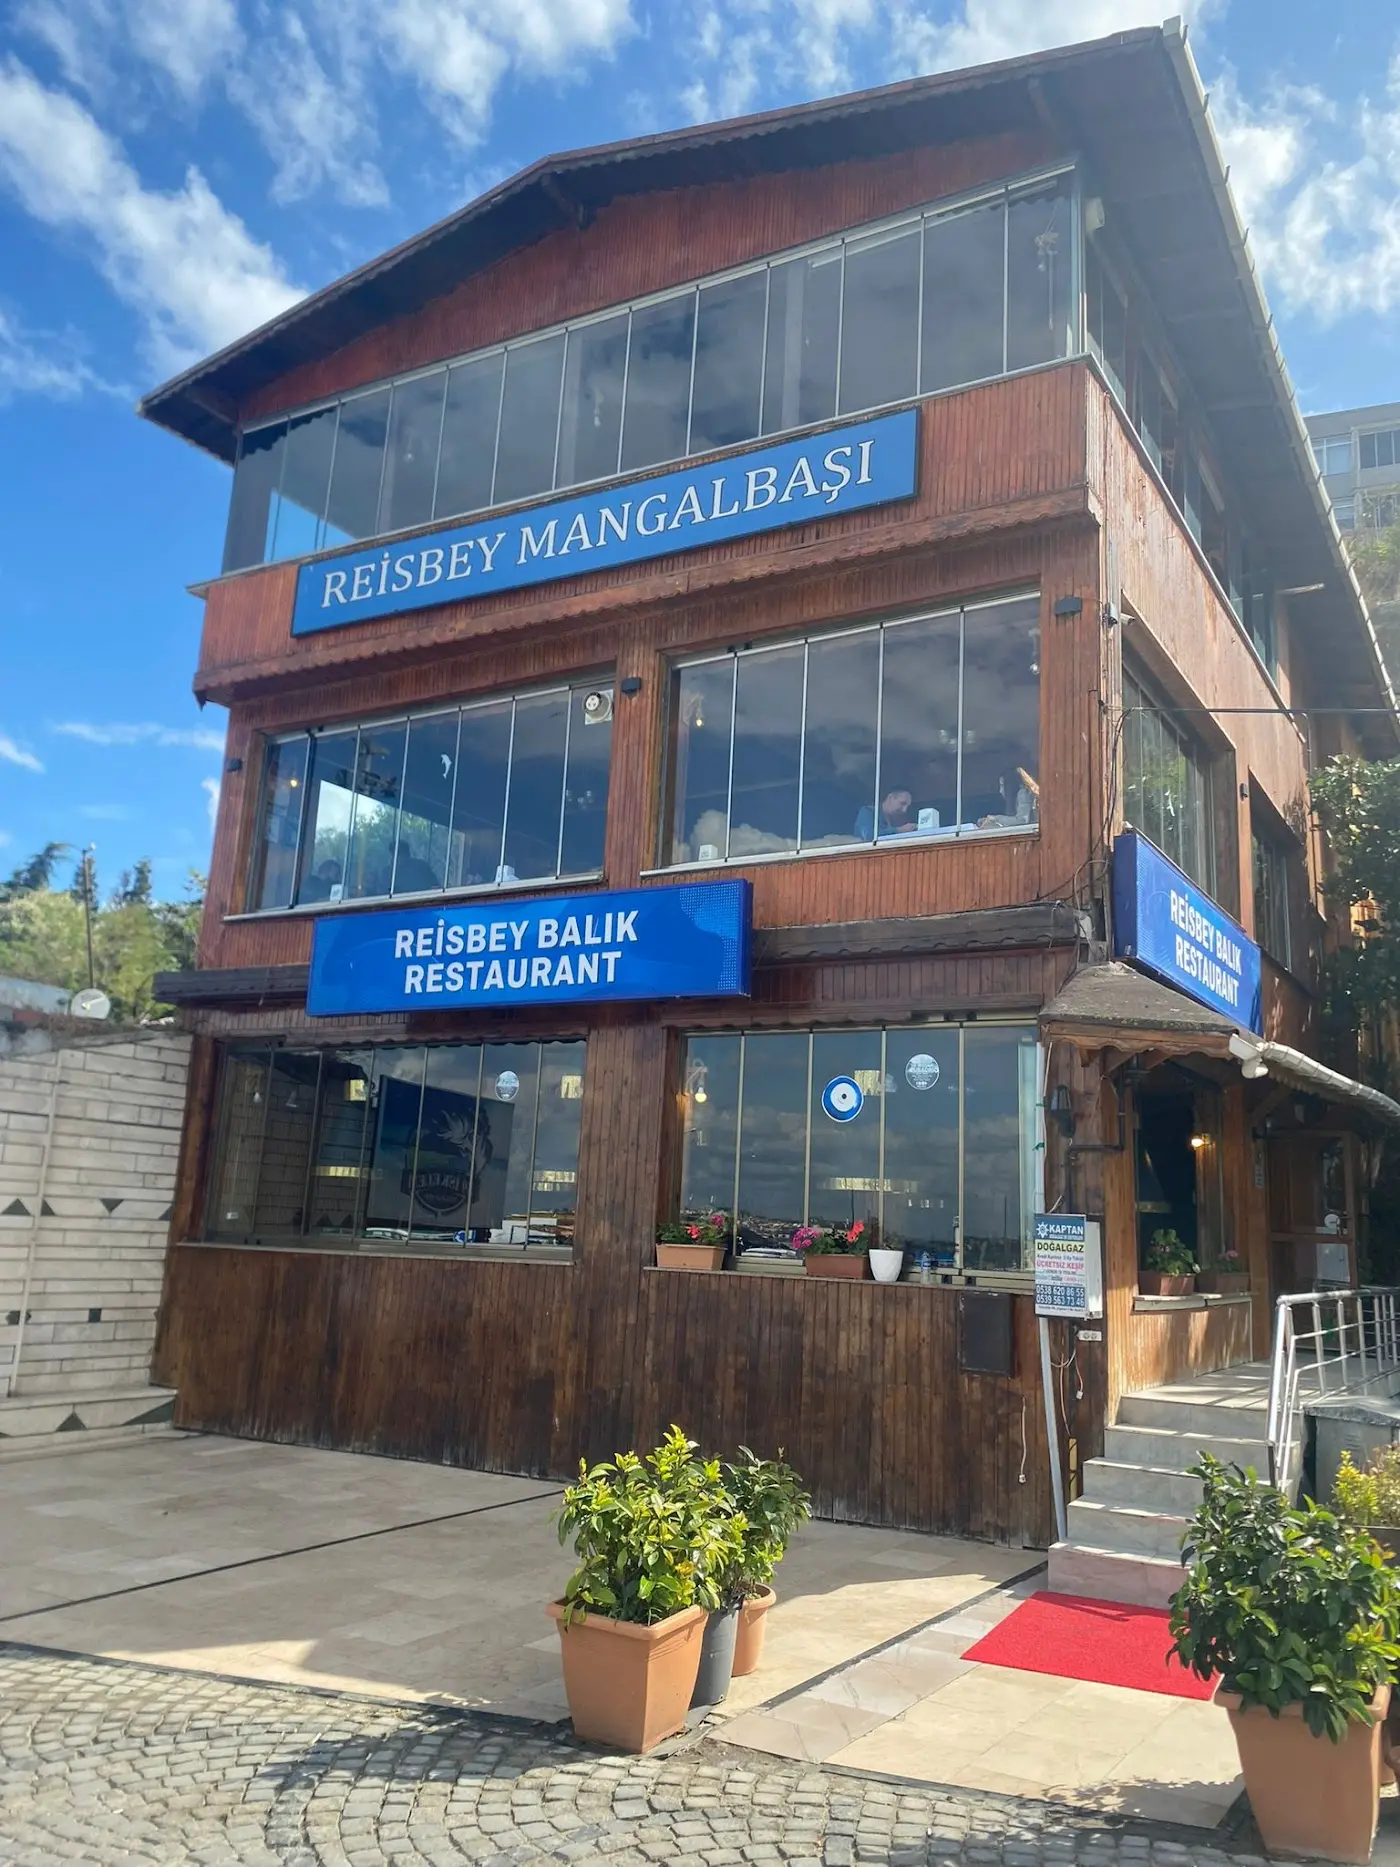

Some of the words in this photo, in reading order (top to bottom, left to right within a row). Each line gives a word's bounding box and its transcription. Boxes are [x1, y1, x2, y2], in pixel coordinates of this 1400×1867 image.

[321, 533, 507, 608] REİSBEY
[517, 440, 875, 565] MANGALBAŞI
[394, 918, 530, 959] REİSBEY
[537, 910, 639, 949] BALIK
[1171, 890, 1215, 953] REİSBEY
[1215, 931, 1242, 975] BALIK
[403, 951, 623, 994] RESTAURANT
[1175, 934, 1240, 1007] RESTAURANT
[1037, 1242, 1084, 1253] DOĞALGAZ
[1049, 1224, 1084, 1235] KAPTAN
[1036, 1284, 1052, 1294] 0538
[1053, 1286, 1065, 1295] 620
[1076, 1288, 1084, 1297] 55
[1036, 1294, 1052, 1304] 0539
[1066, 1296, 1075, 1306] 73
